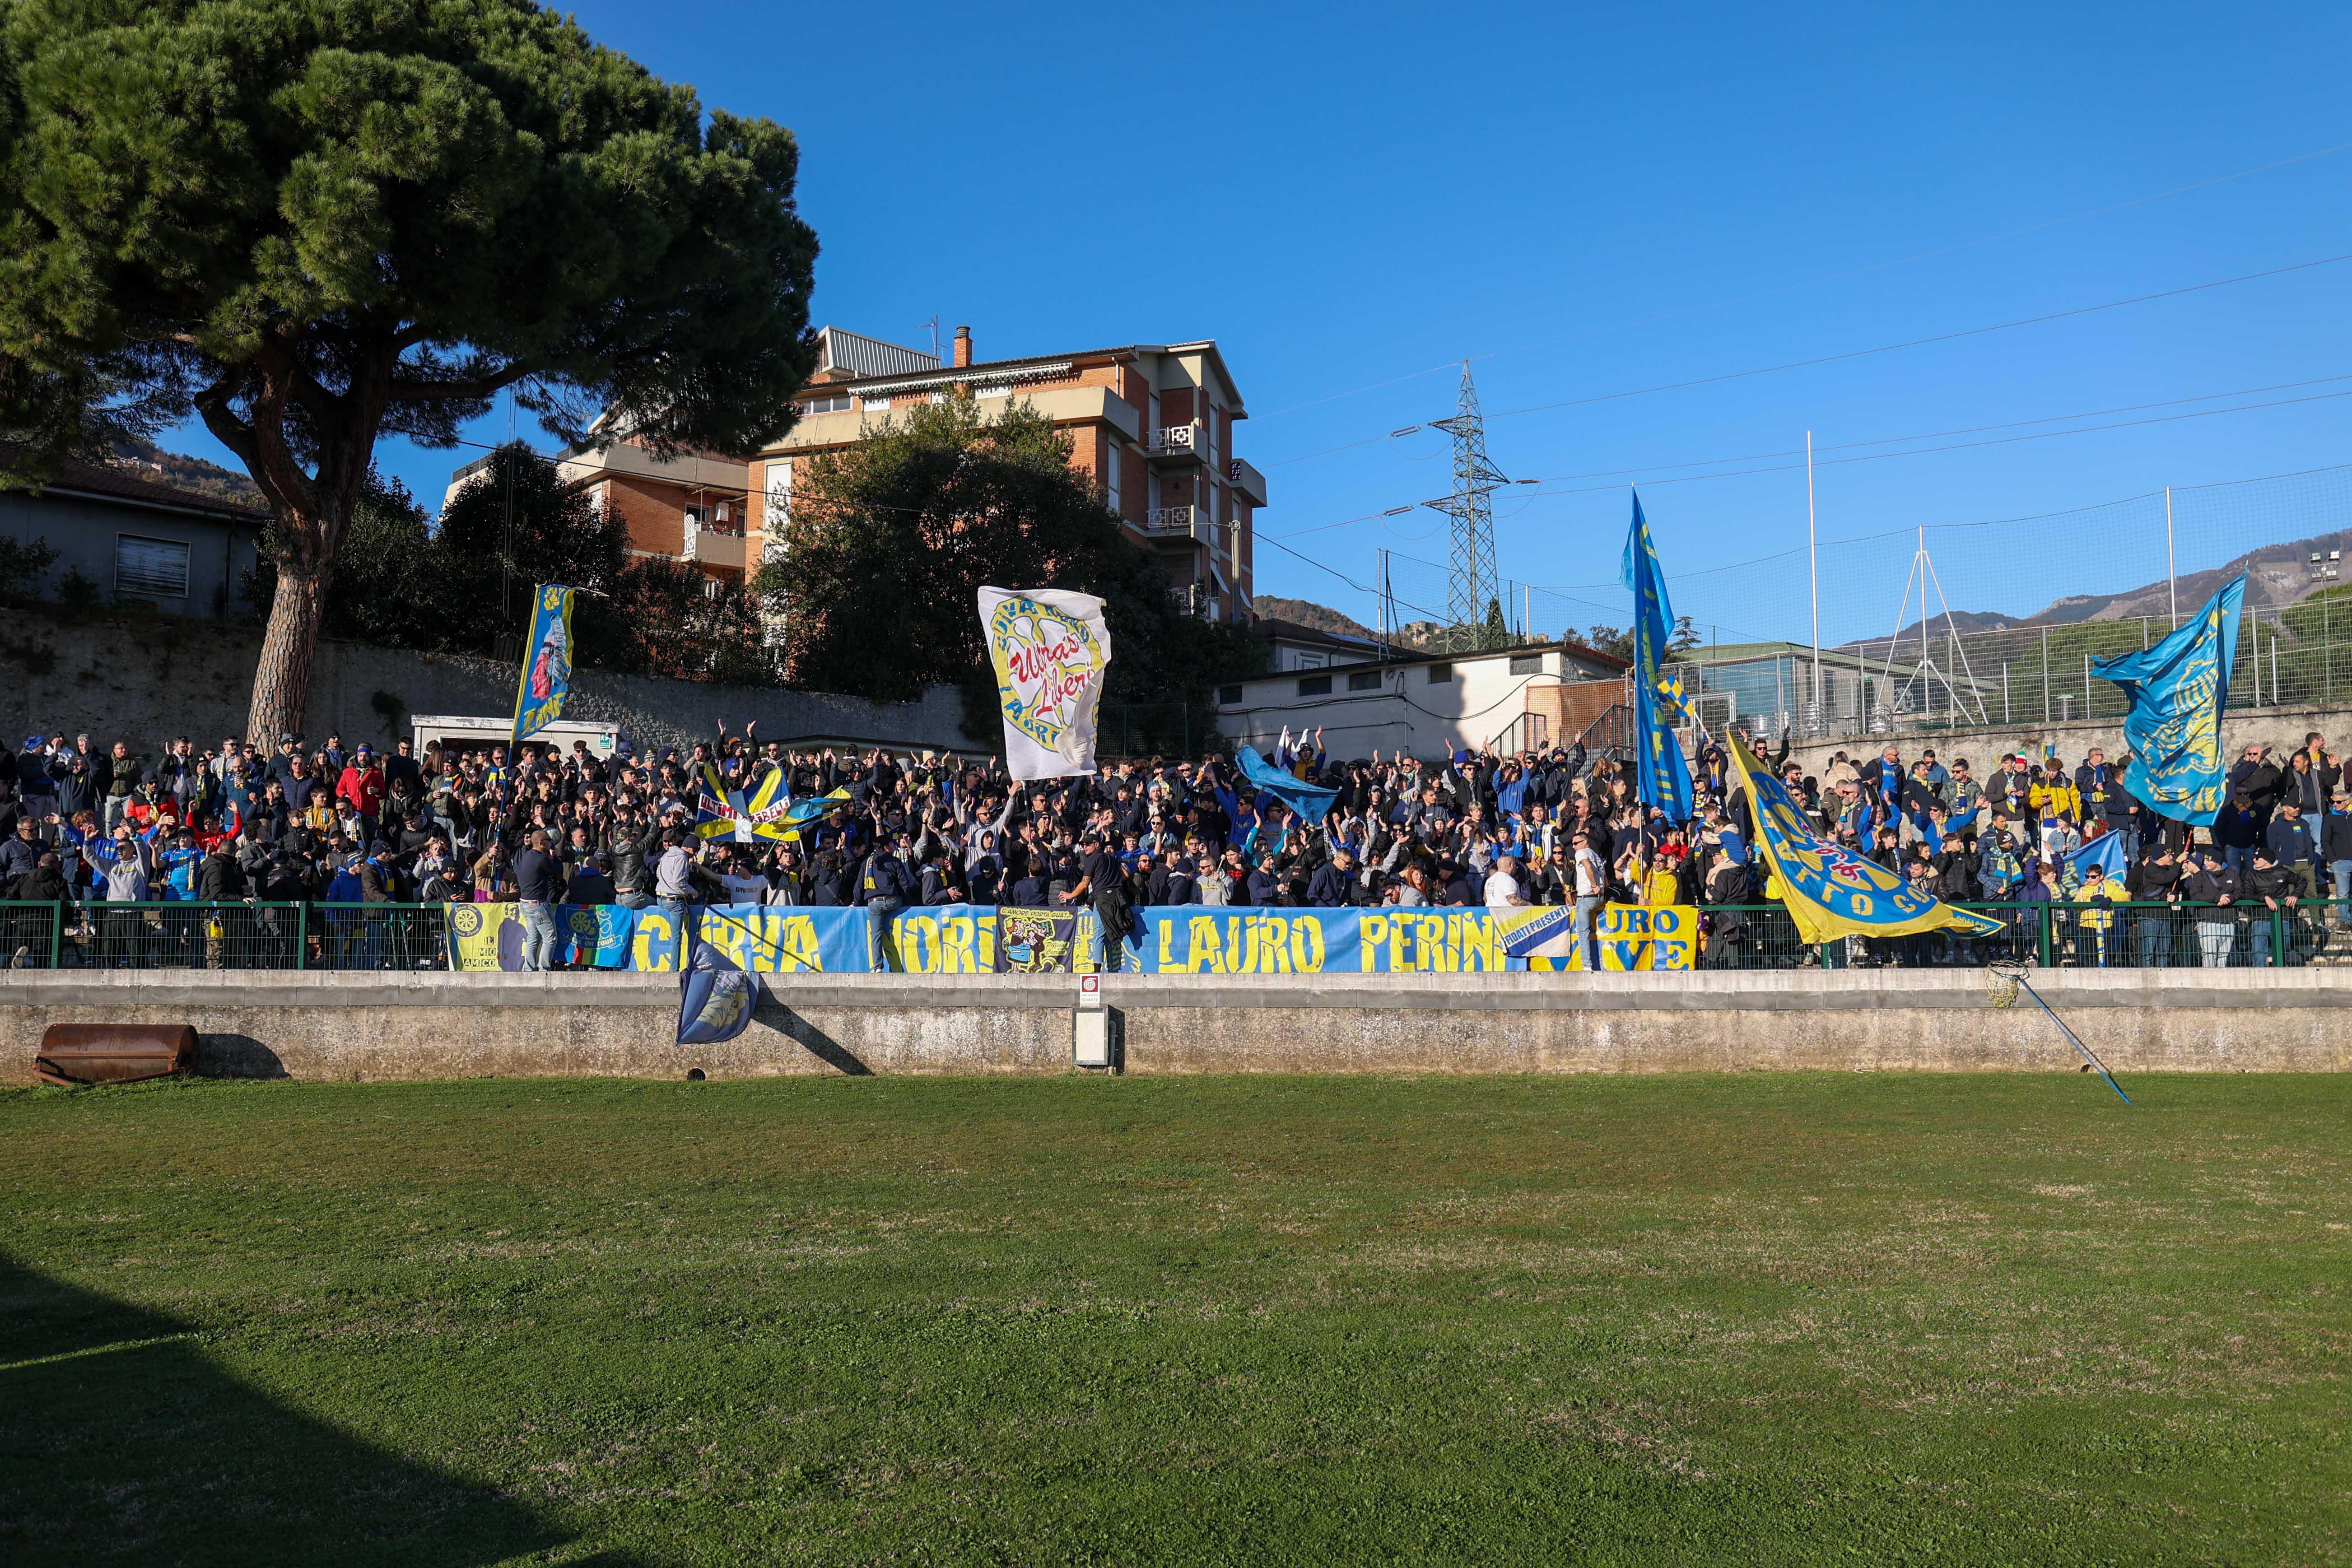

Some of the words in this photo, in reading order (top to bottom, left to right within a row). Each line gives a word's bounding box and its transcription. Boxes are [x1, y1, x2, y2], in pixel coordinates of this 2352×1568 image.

[1530, 905, 1570, 932] PRESENTI
[478, 948, 496, 957] MIO
[1159, 915, 1325, 973] LAURO
[464, 958, 496, 967] AMICO
